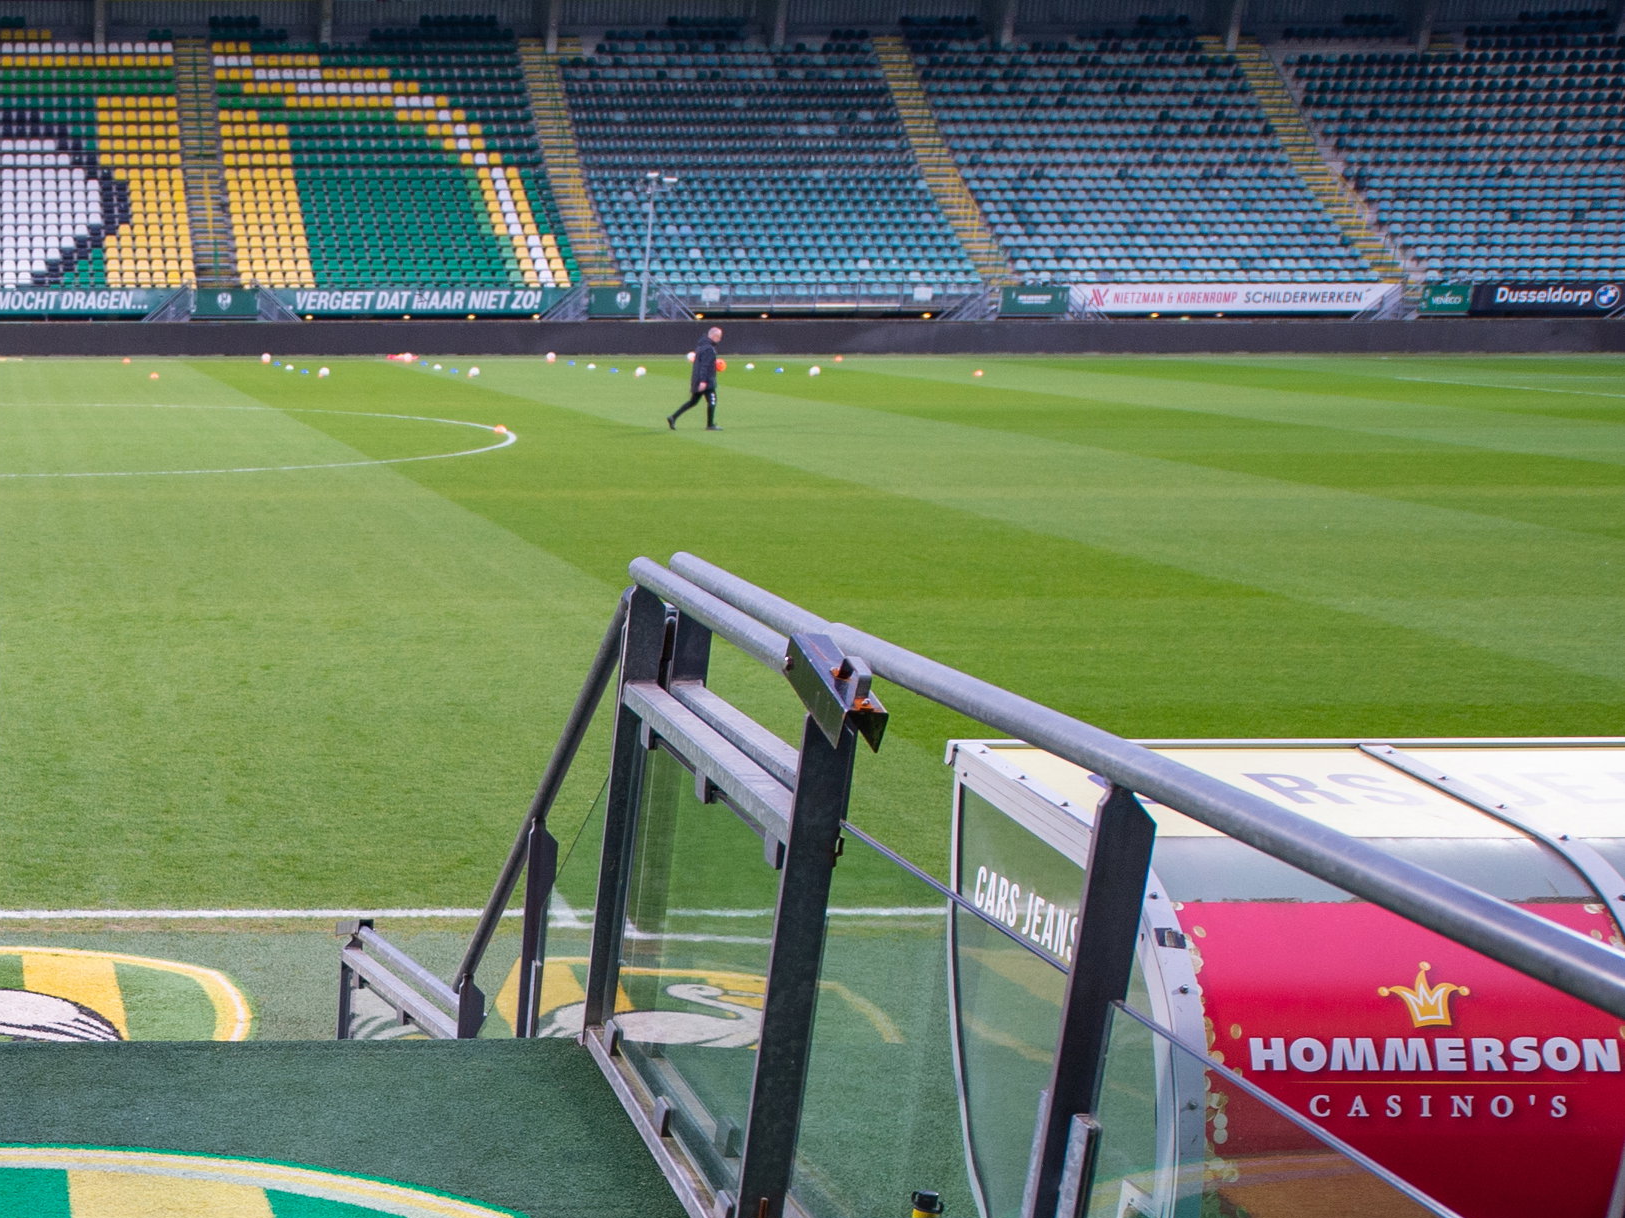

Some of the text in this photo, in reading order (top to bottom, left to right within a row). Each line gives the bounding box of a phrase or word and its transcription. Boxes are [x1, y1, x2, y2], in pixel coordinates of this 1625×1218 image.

[61, 291, 148, 310] DRAGEN...
[375, 291, 411, 310] DAT
[414, 291, 466, 310] MAAR
[469, 291, 509, 310] NIET
[510, 291, 542, 310] ZO!
[1243, 291, 1363, 304] SCHILDERWERKEN
[1494, 287, 1593, 306] Dusseldorp
[974, 865, 1079, 963] CARS JEANS
[1248, 1036, 1622, 1072] HOMMERSON
[1309, 1094, 1568, 1119] CASINO'S
